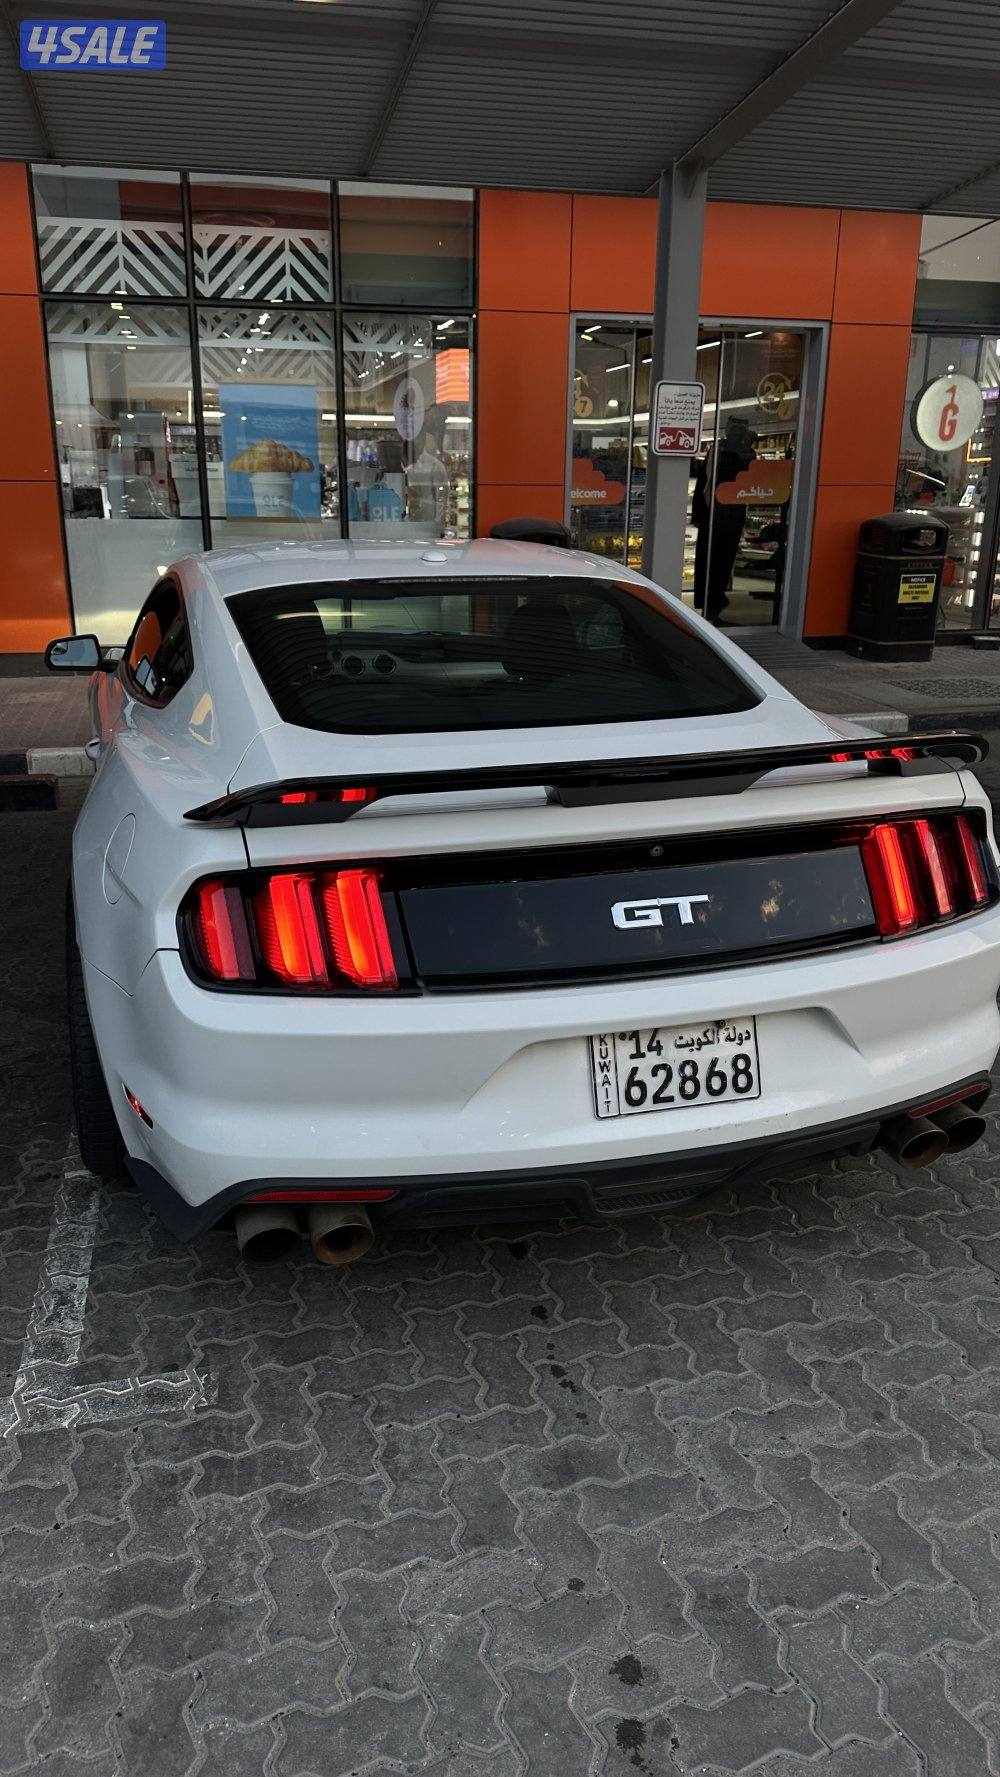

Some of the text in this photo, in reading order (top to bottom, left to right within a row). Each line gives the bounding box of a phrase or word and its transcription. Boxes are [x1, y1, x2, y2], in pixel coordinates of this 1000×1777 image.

[571, 488, 607, 499] elcome
[736, 486, 774, 499] حياكم
[611, 894, 710, 930] GT
[628, 1028, 664, 1060] 14
[674, 1025, 751, 1053] دولة الكويت
[598, 1033, 613, 1113] KUWAIT
[624, 1052, 754, 1107] 62868
